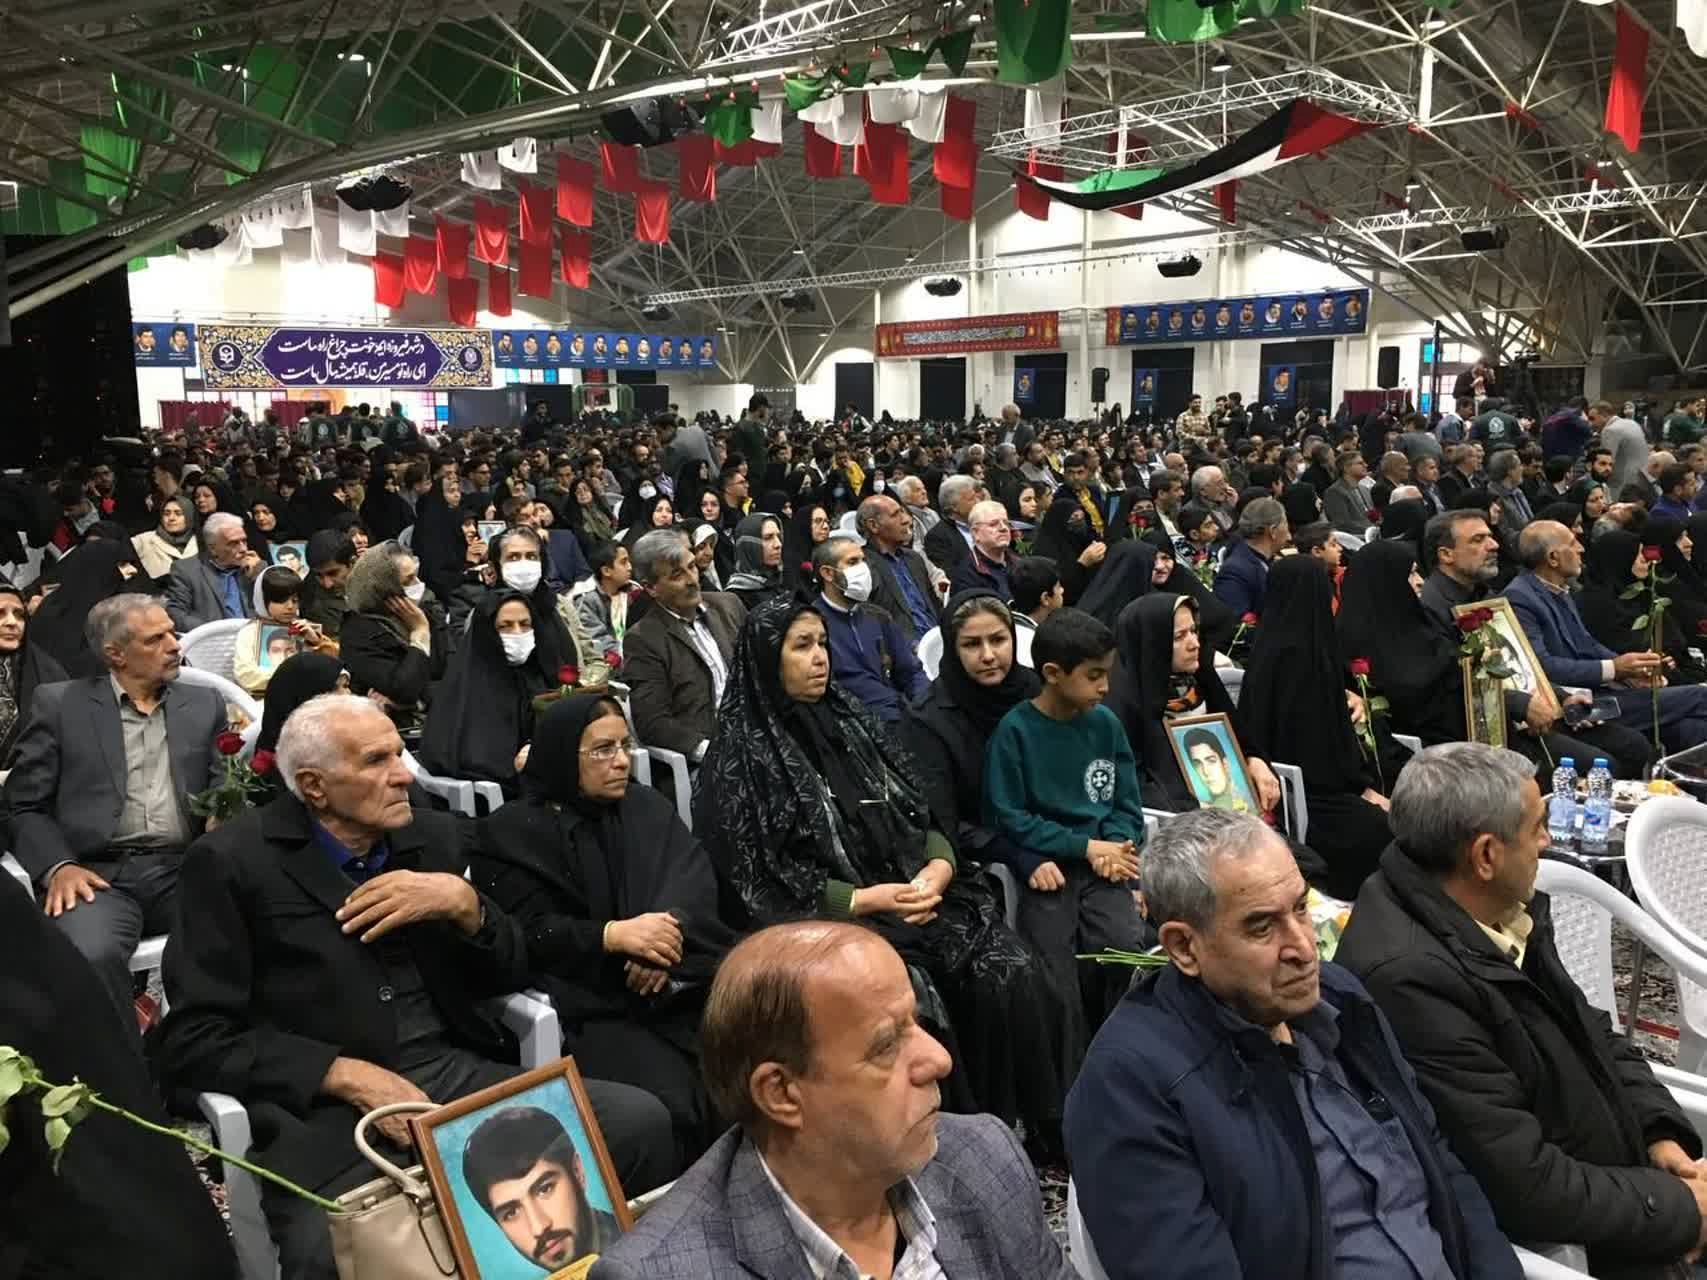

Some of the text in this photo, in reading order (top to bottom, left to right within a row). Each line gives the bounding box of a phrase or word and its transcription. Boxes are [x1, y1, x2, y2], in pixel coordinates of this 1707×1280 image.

[278, 336, 318, 352] ماست
[327, 333, 348, 360] چراغ
[280, 364, 317, 379] ماست
[376, 362, 401, 383] مسیر
[397, 362, 408, 379] تو
[413, 362, 426, 380] ای
